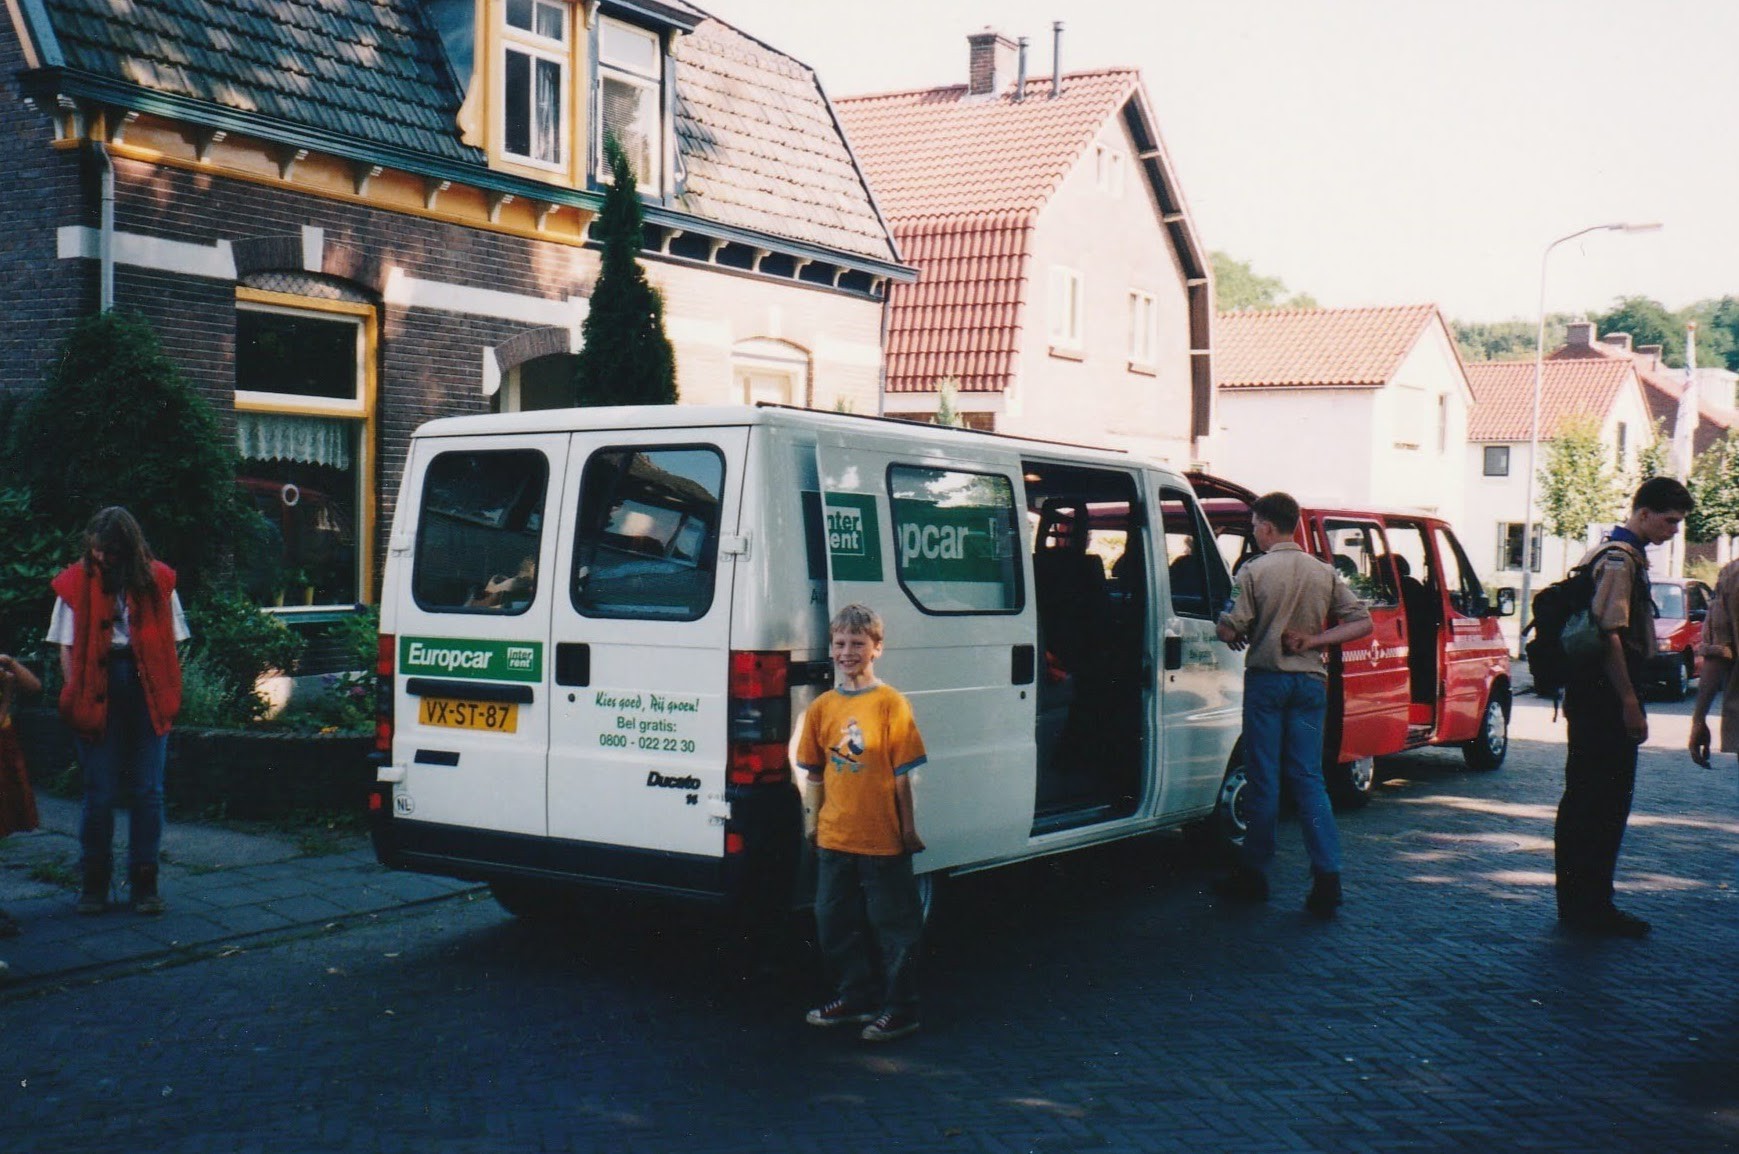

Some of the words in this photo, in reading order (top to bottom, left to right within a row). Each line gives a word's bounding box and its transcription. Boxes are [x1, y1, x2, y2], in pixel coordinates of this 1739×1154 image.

[898, 523, 968, 567] pcar
[408, 643, 493, 671] Europcar
[509, 649, 532, 660] inter
[509, 659, 530, 668] rent
[596, 691, 616, 707] Kies
[426, 700, 511, 729] VX-ST-87
[617, 716, 636, 729] Bel
[639, 719, 677, 733] gratis:
[599, 734, 627, 747] 0800
[639, 737, 659, 750] 022
[663, 739, 677, 751] 22
[680, 740, 695, 753] 30
[647, 771, 701, 790] Ducato
[397, 798, 411, 811] NL
